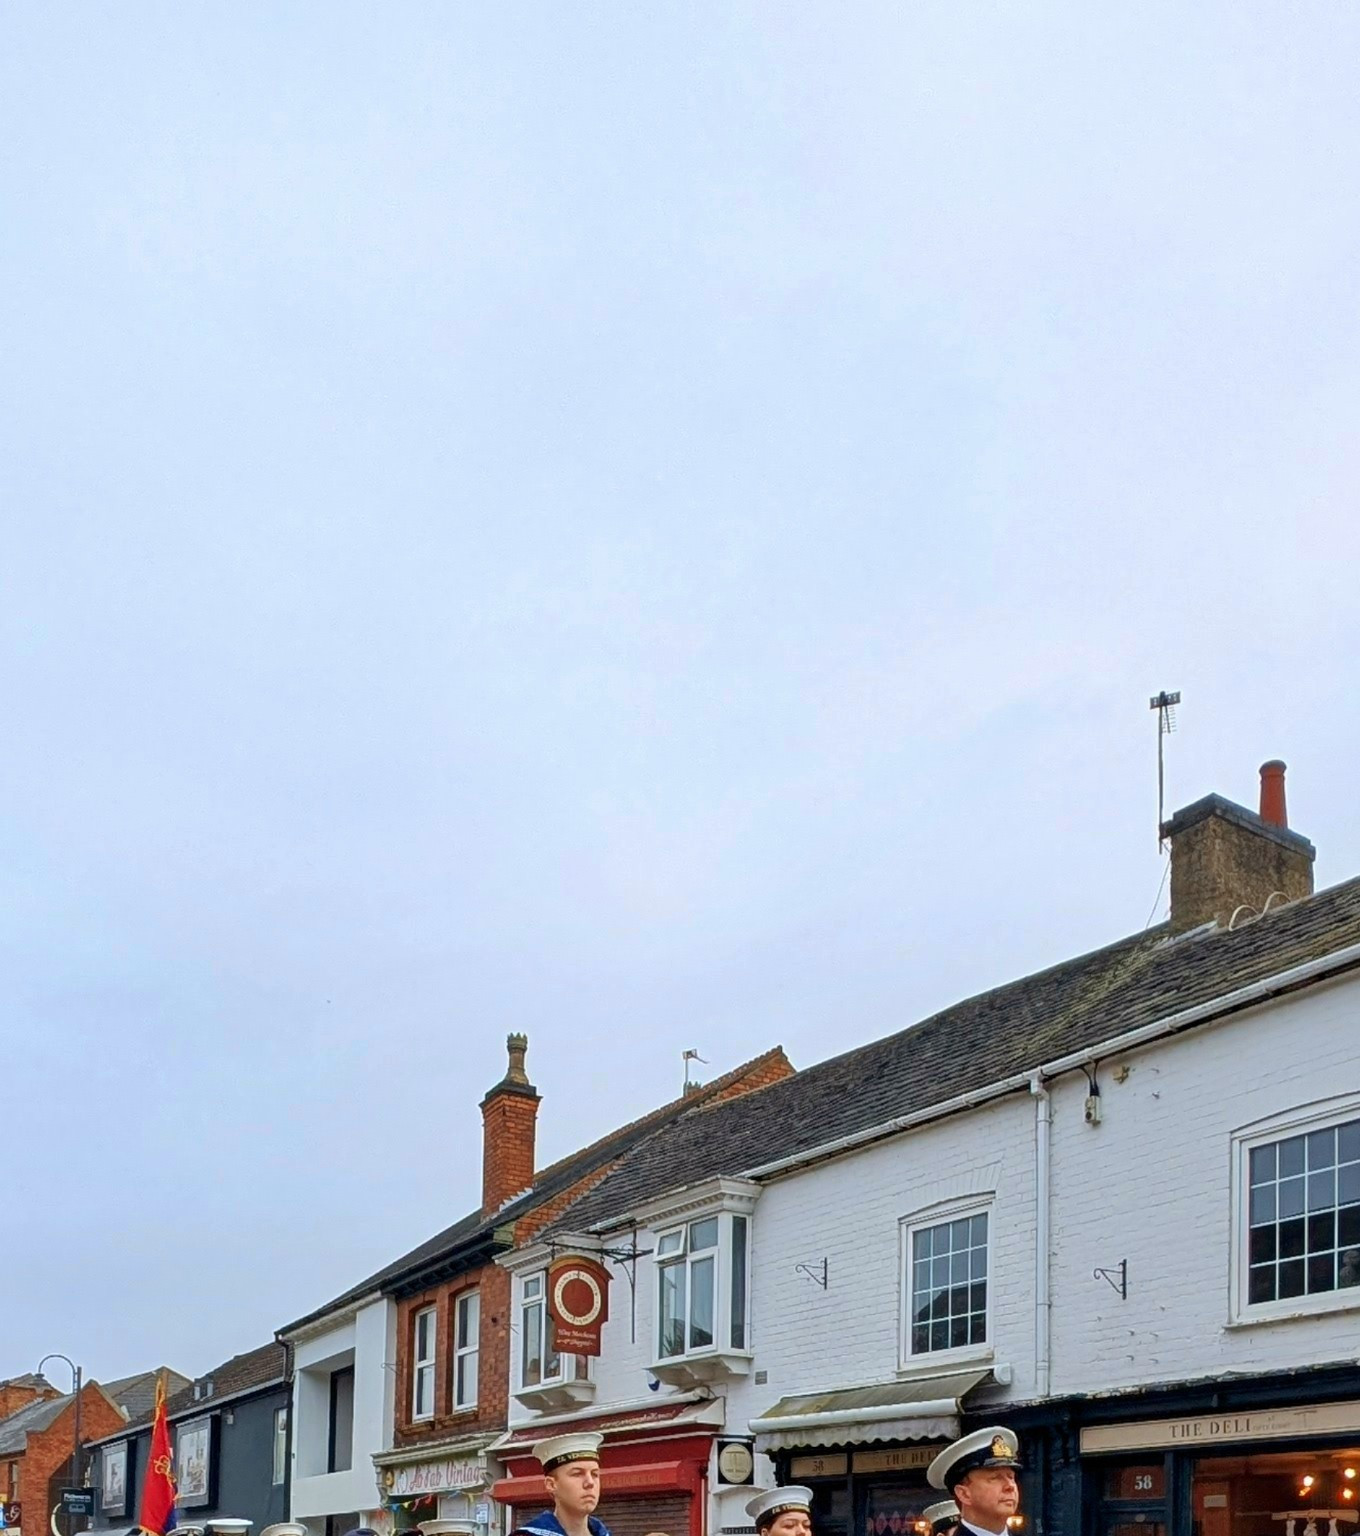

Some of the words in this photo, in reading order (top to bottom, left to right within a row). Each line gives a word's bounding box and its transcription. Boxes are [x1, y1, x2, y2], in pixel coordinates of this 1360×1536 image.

[1169, 1421, 1202, 1439] THE
[1209, 1418, 1250, 1435] DELI
[812, 1460, 825, 1473] 58
[885, 1452, 907, 1466] THE
[446, 1461, 483, 1486] Vintag
[1134, 1474, 1153, 1490] 58
